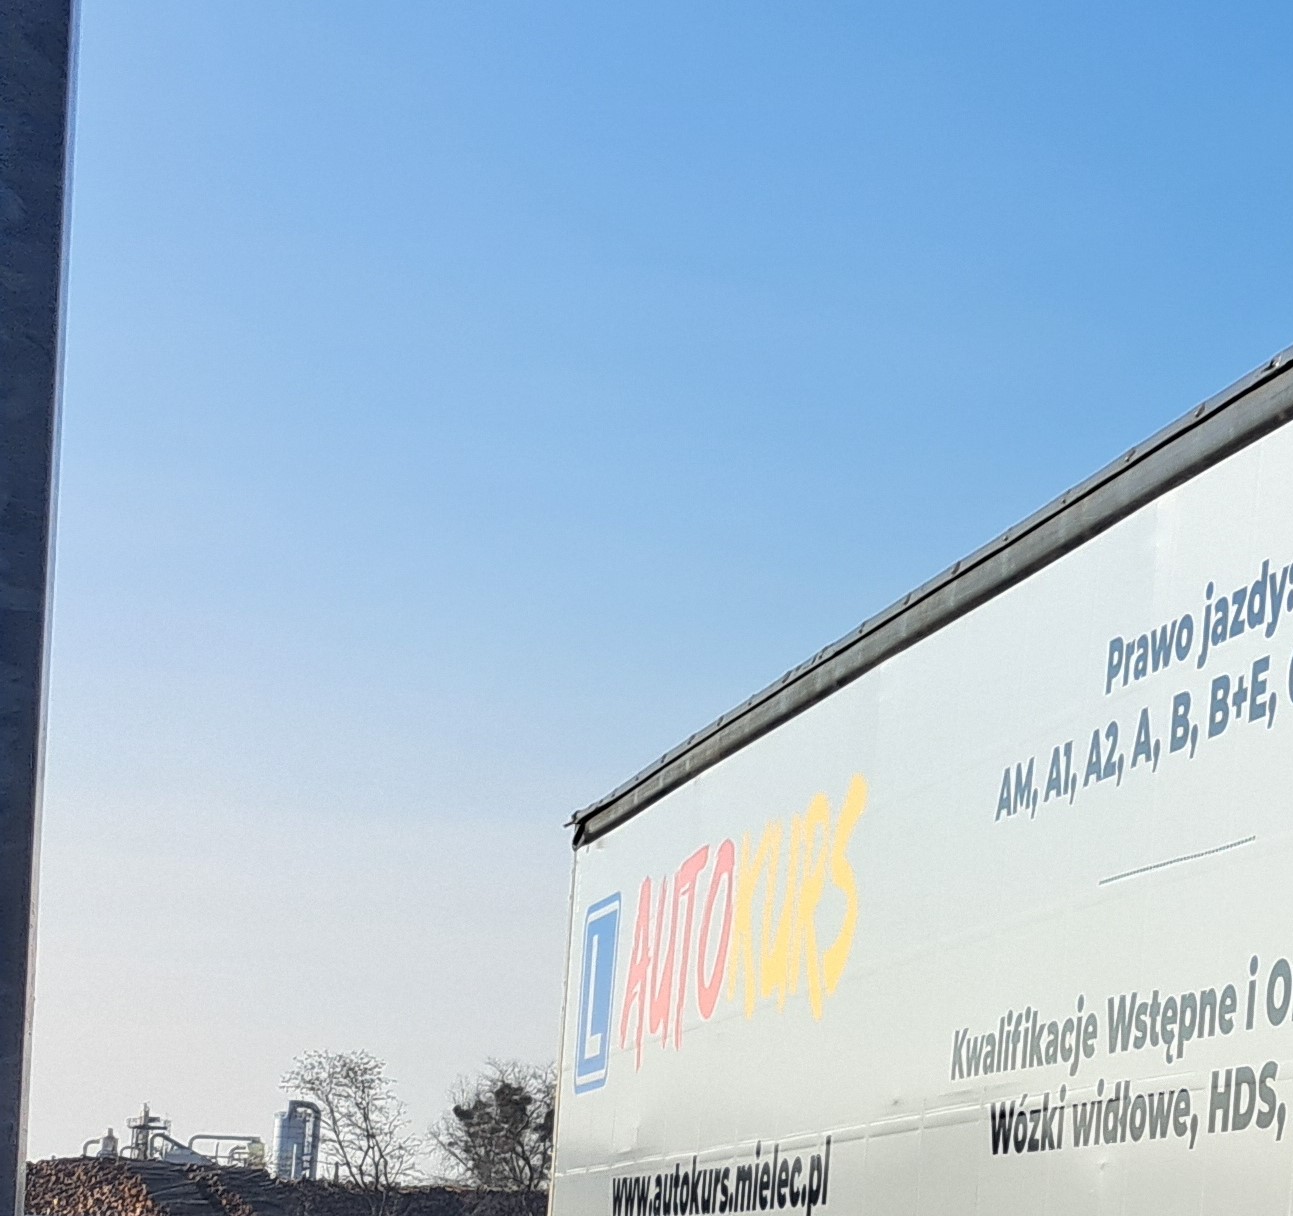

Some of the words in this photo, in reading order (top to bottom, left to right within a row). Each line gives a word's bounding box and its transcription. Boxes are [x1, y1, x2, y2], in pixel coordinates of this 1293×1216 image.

[1105, 614, 1193, 694] Prawo
[995, 756, 1039, 821] AM,
[1043, 740, 1077, 805] A1,
[1083, 721, 1124, 786] A2,
[1131, 707, 1161, 772] A,
[1170, 691, 1198, 758] B,
[1208, 655, 1277, 739] B+E,
[584, 933, 601, 1059] L
[950, 994, 1098, 1081] Kwalifikacje
[1107, 983, 1237, 1064] Wstępne
[1245, 954, 1259, 1030] i
[990, 1085, 1067, 1155] Wózki
[1073, 1078, 1198, 1150] widłowe,
[1207, 1060, 1287, 1141] HDS,
